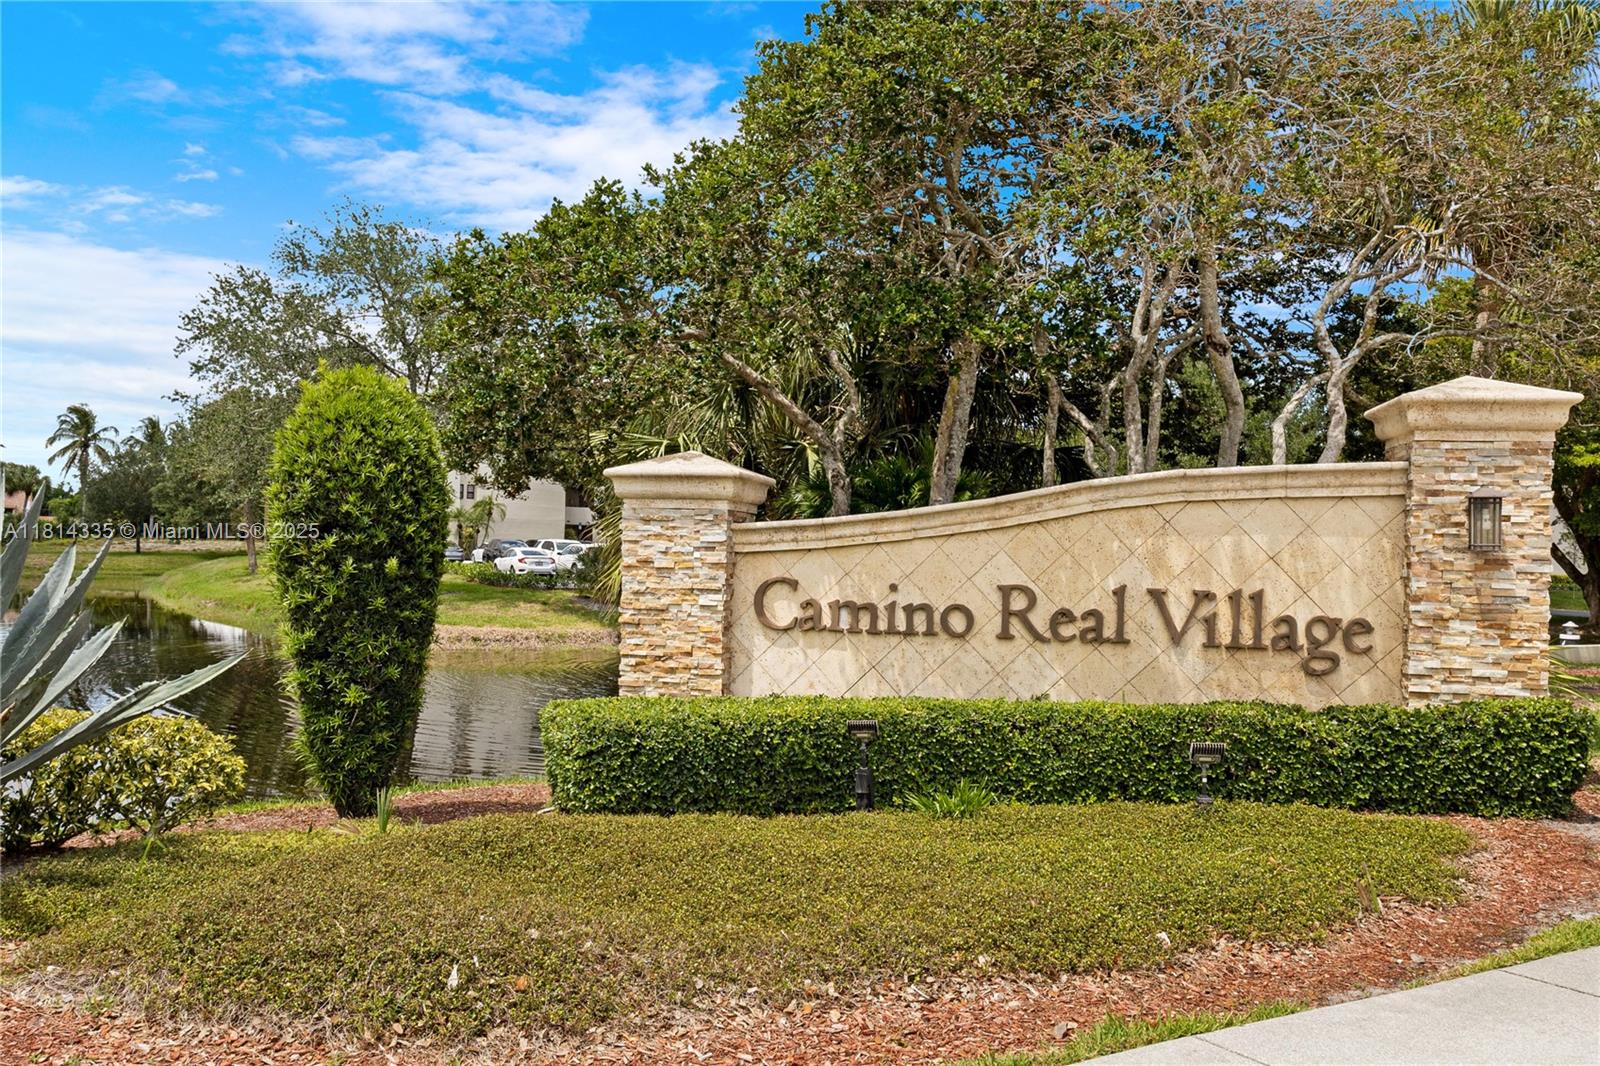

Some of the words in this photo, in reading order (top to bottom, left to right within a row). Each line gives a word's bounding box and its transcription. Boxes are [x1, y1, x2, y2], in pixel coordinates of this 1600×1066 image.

[753, 576, 975, 639] Camino
[996, 583, 1131, 645] Real
[1146, 587, 1375, 676] Village
